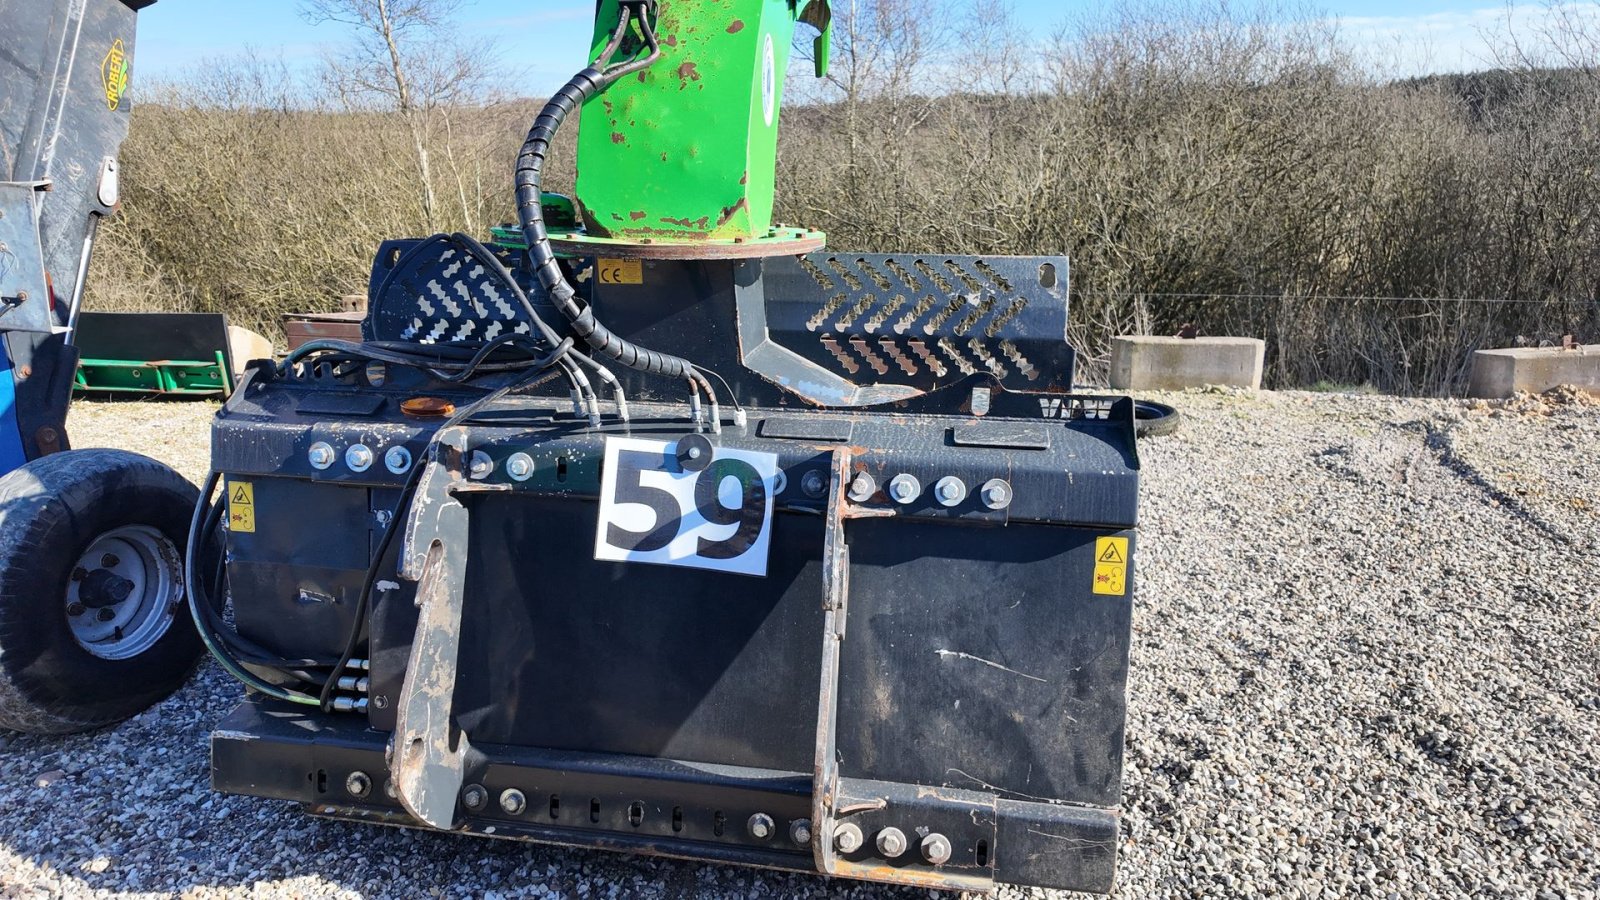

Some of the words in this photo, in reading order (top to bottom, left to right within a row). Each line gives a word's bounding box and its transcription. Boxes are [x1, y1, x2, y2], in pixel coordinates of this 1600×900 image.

[107, 46, 123, 103] ROBERT
[601, 268, 622, 282] CE
[606, 449, 766, 560] 59
